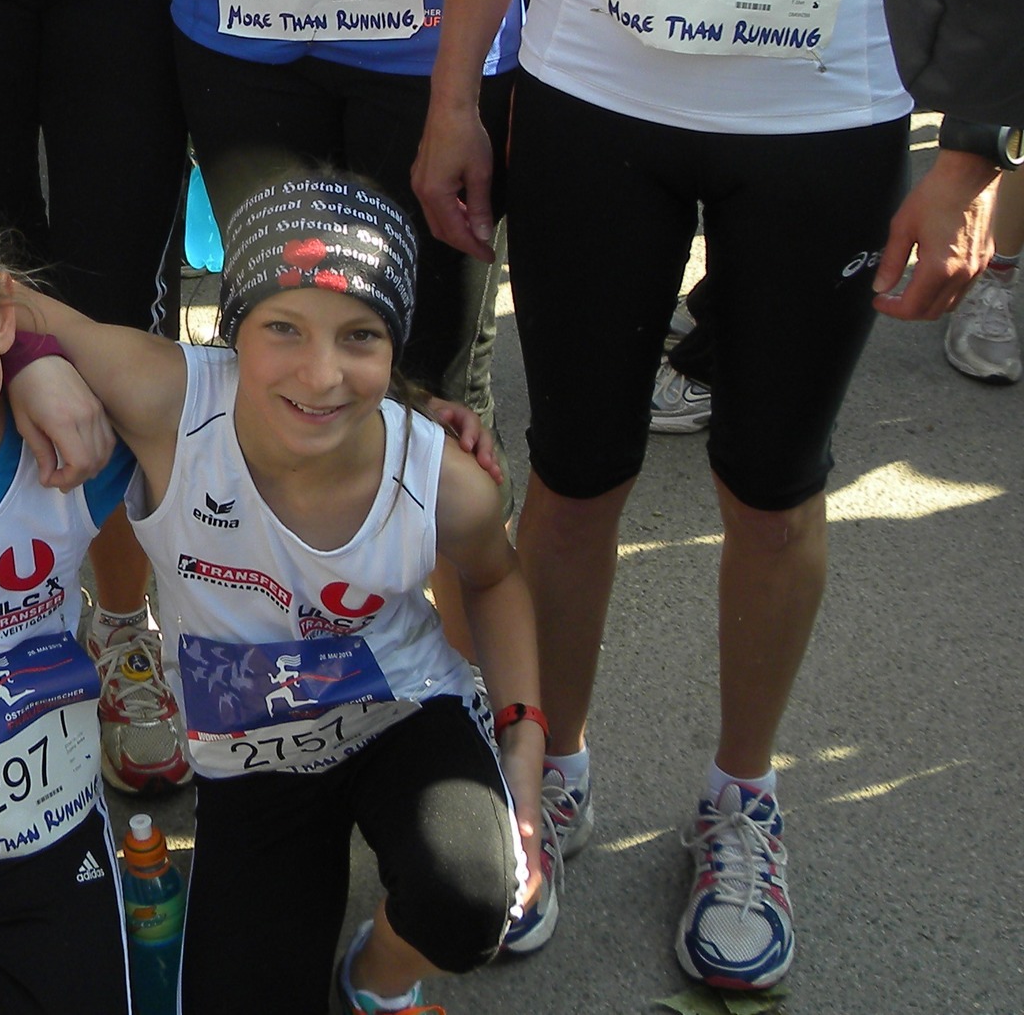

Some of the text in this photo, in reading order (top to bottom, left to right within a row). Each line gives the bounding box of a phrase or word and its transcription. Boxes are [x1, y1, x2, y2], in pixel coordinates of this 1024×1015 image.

[227, 5, 272, 29] MORE
[279, 11, 327, 32] THAN
[608, 0, 822, 49] MORE THAN RUNNING
[282, 180, 348, 195] Hofstadl
[355, 190, 403, 225] Hofstadl
[311, 200, 378, 225] Hofstadl
[276, 218, 348, 235] Hofstadl
[325, 244, 380, 269] ofstadl
[193, 509, 240, 529] erima
[199, 562, 289, 603] TRANSFER
[231, 716, 343, 770] 2757
[77, 863, 105, 883] adidas
